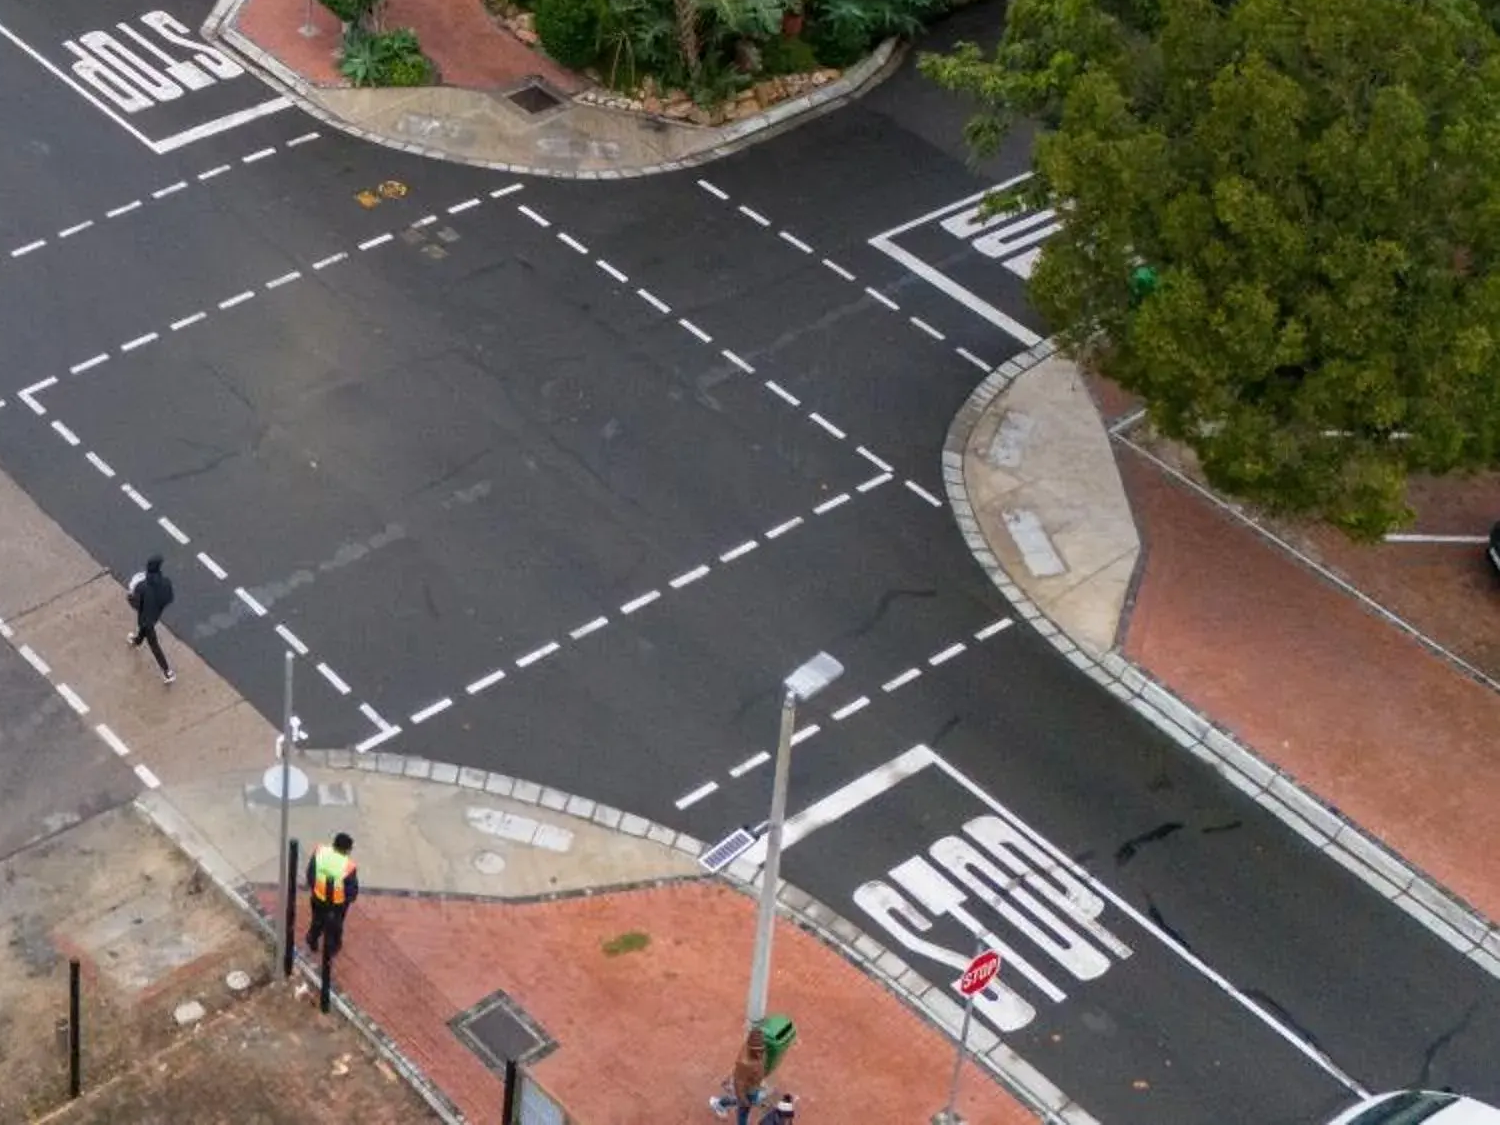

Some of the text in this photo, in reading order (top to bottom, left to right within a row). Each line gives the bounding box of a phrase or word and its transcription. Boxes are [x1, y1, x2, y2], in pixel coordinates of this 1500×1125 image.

[61, 10, 245, 113] STOP
[852, 815, 1134, 1032] STOP
[963, 958, 997, 989] STOP
